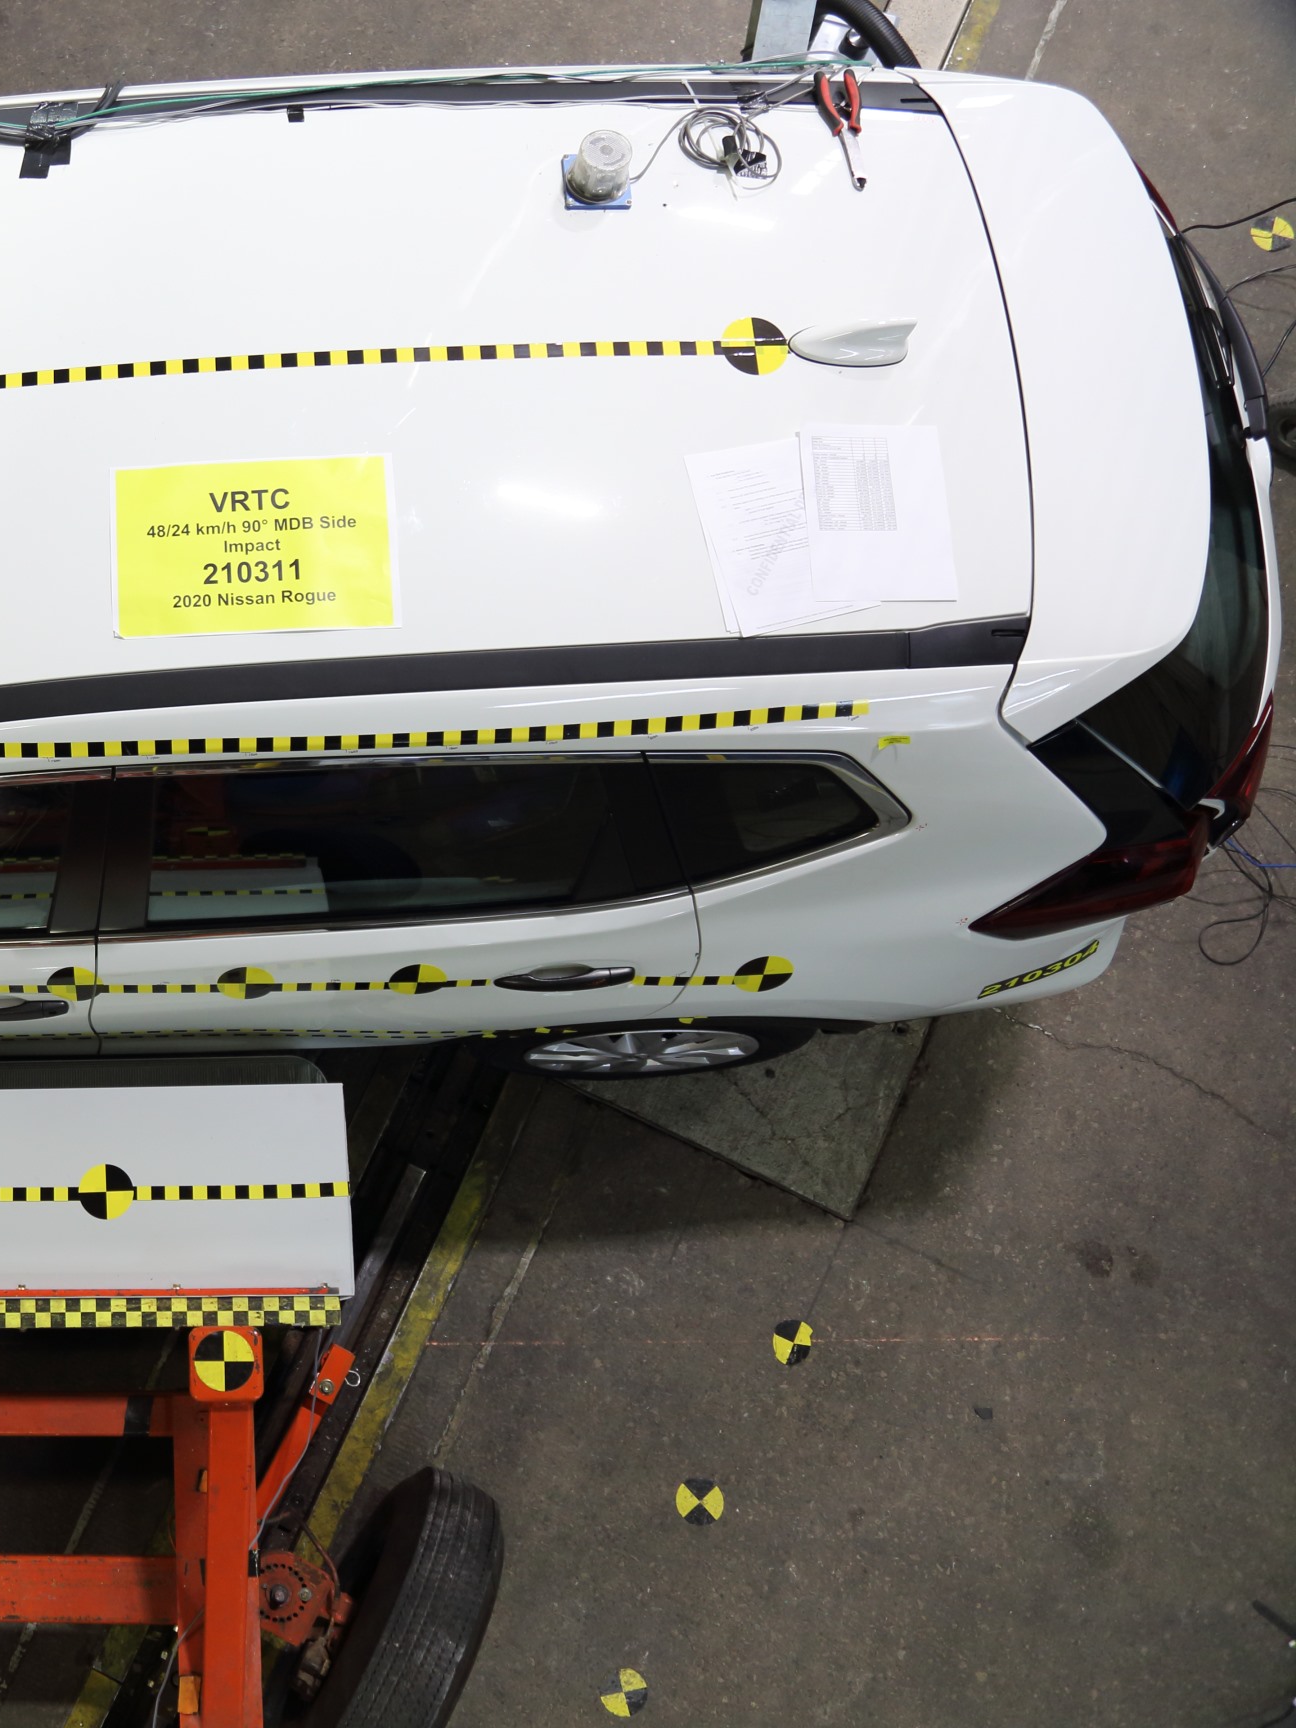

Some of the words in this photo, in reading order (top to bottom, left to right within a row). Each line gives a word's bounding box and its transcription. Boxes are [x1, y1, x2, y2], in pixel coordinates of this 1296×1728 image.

[209, 488, 290, 513] VRTC
[147, 524, 190, 538] 48/24
[196, 521, 236, 535] km/h
[242, 519, 268, 533] 90°
[274, 517, 314, 531] MDB
[320, 515, 357, 529] Side
[224, 539, 281, 555] Impact
[203, 559, 300, 584] 210311
[173, 594, 211, 608] 2020
[218, 592, 275, 606] Nissan
[281, 590, 337, 605] Rogue
